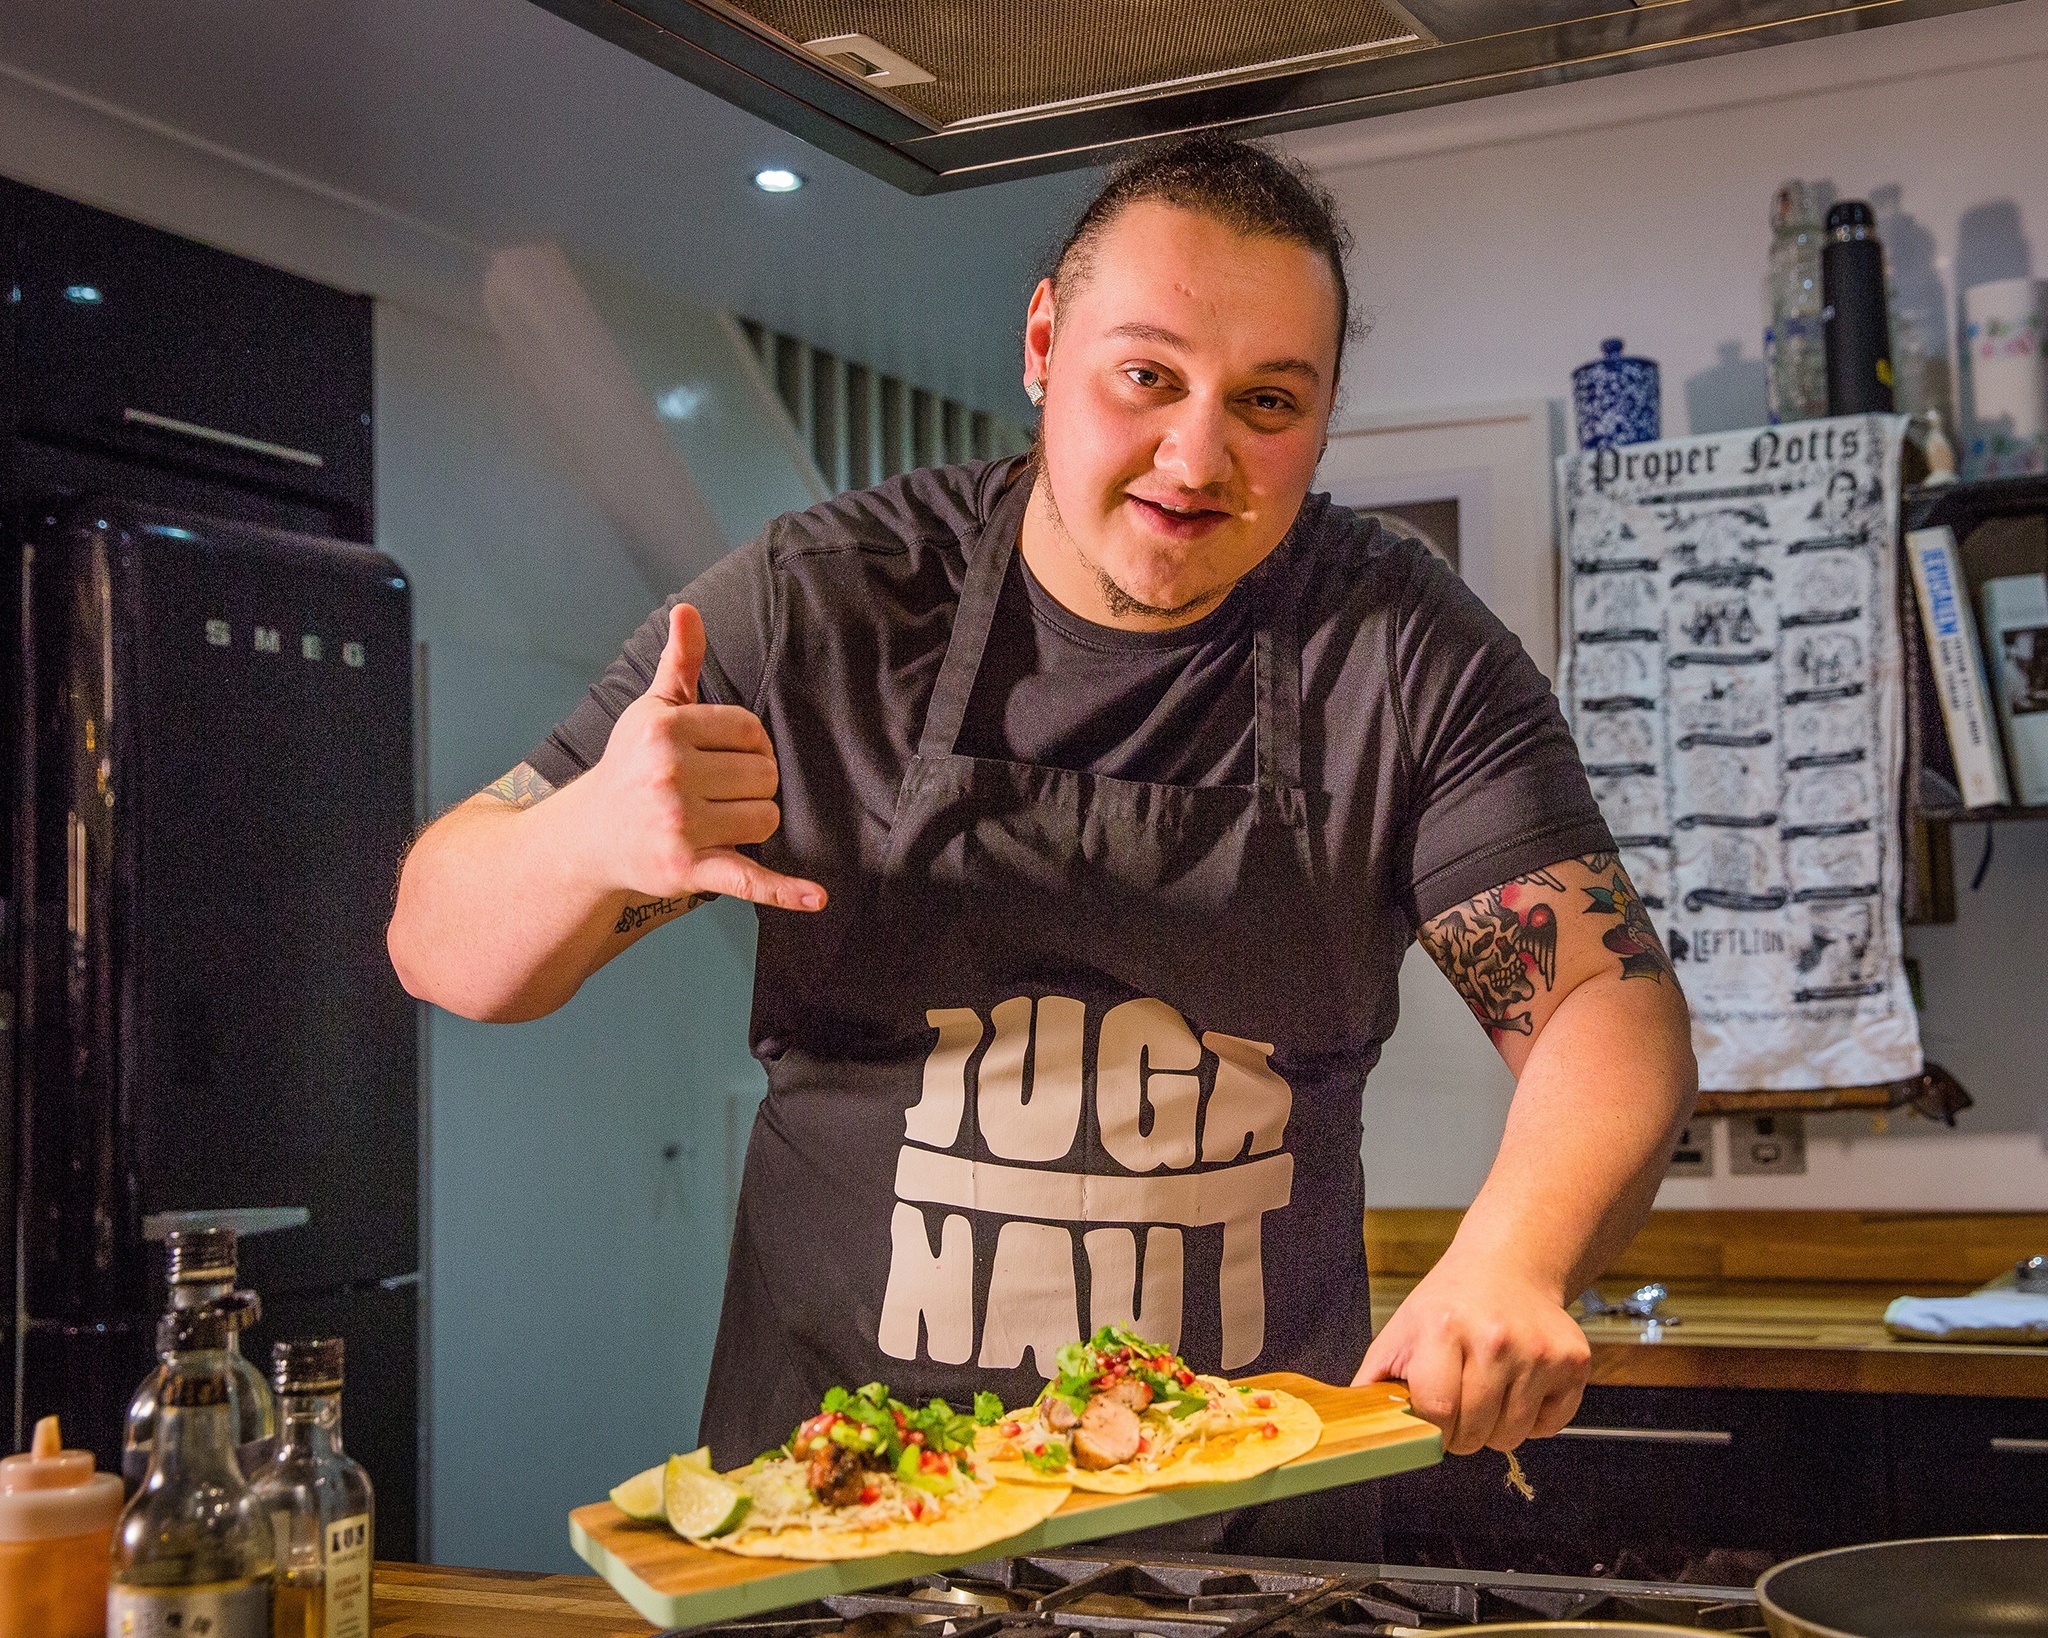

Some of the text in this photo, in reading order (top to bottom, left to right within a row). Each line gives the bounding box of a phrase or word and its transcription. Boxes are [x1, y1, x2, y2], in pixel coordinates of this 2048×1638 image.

[1589, 427, 1860, 492] Proper Notts
[205, 619, 366, 668] SMEG
[1692, 928, 1785, 963] LEFTLION
[904, 995, 1293, 1173] JUGA
[878, 1146, 1294, 1380] NAUT
